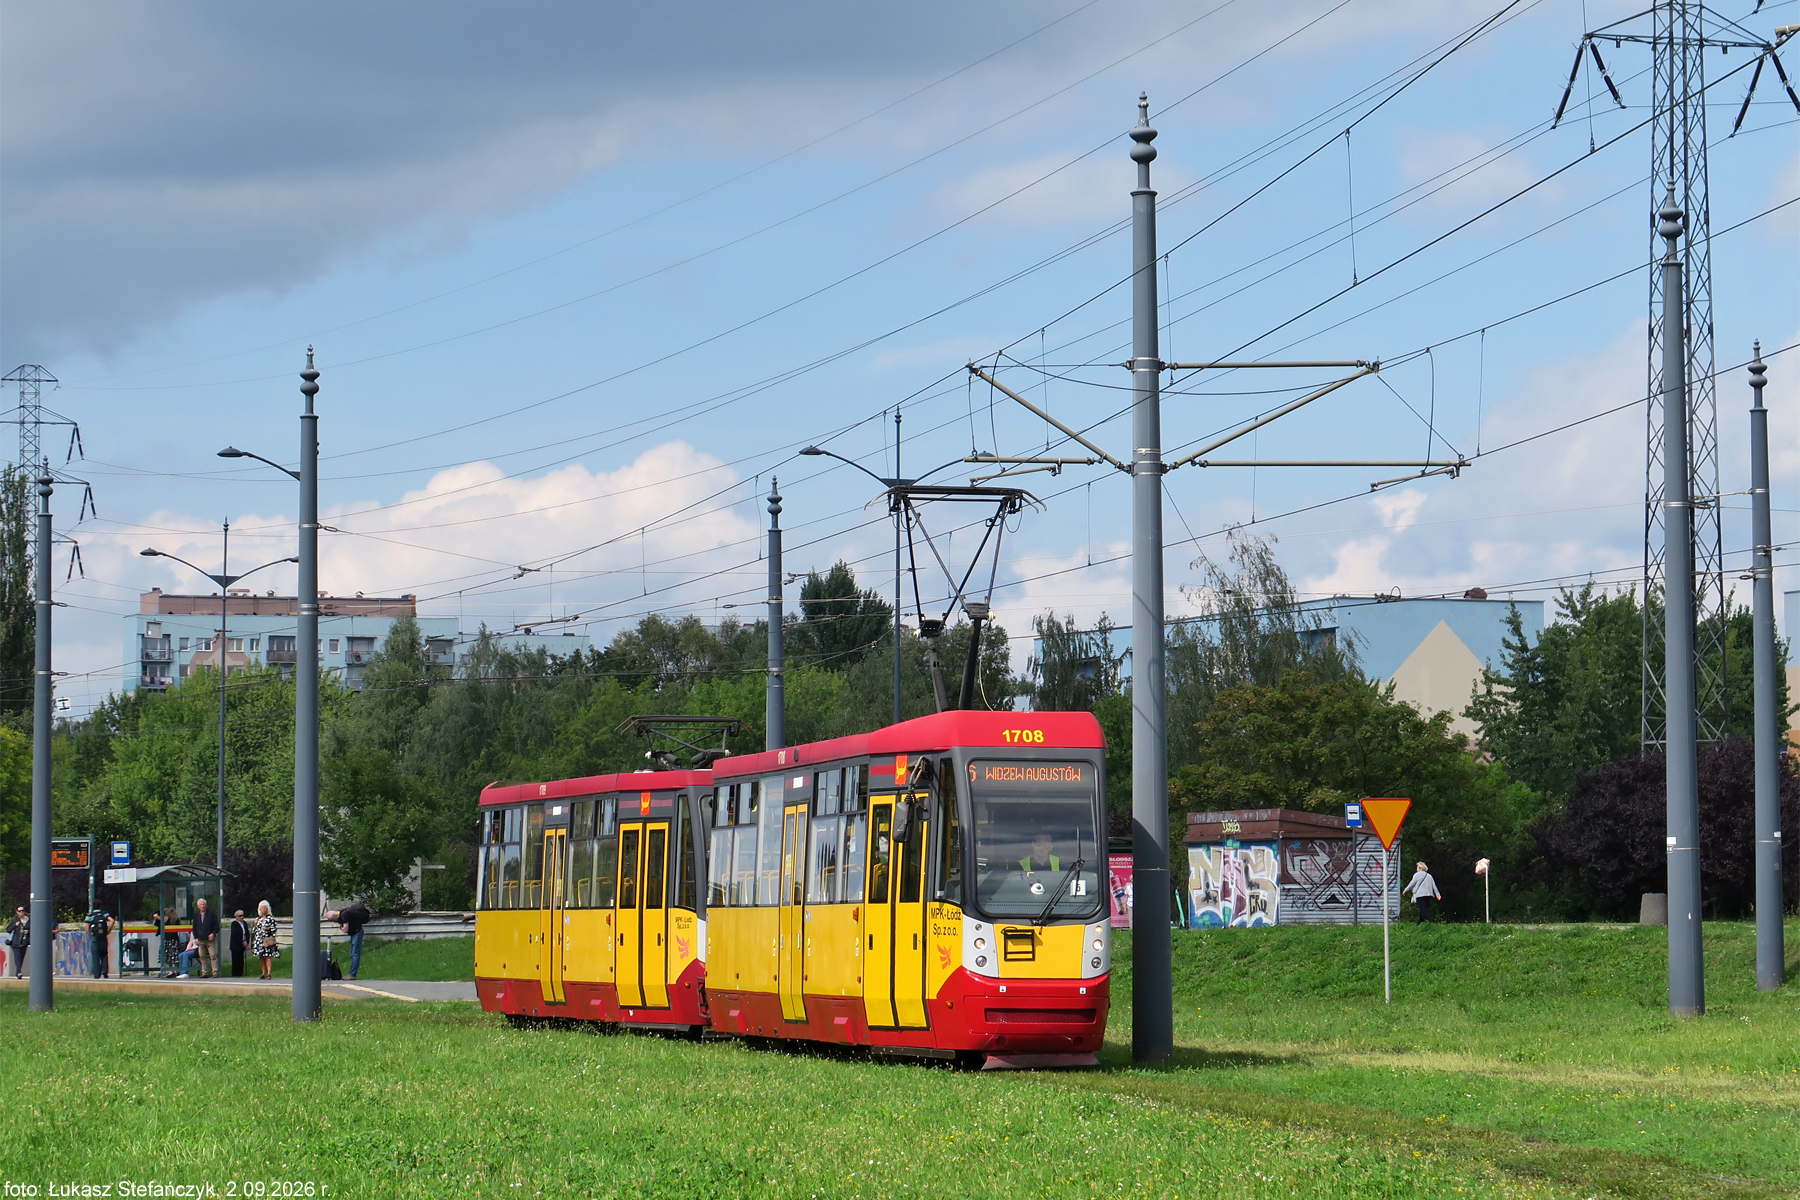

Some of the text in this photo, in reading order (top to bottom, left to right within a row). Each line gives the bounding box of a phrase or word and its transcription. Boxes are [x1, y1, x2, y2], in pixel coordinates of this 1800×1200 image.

[1002, 729, 1044, 743] 1708
[985, 766, 1024, 781] WIDZEW
[1026, 765, 1082, 781] AUGUSTÓW
[930, 907, 961, 920] MPK-Łódź
